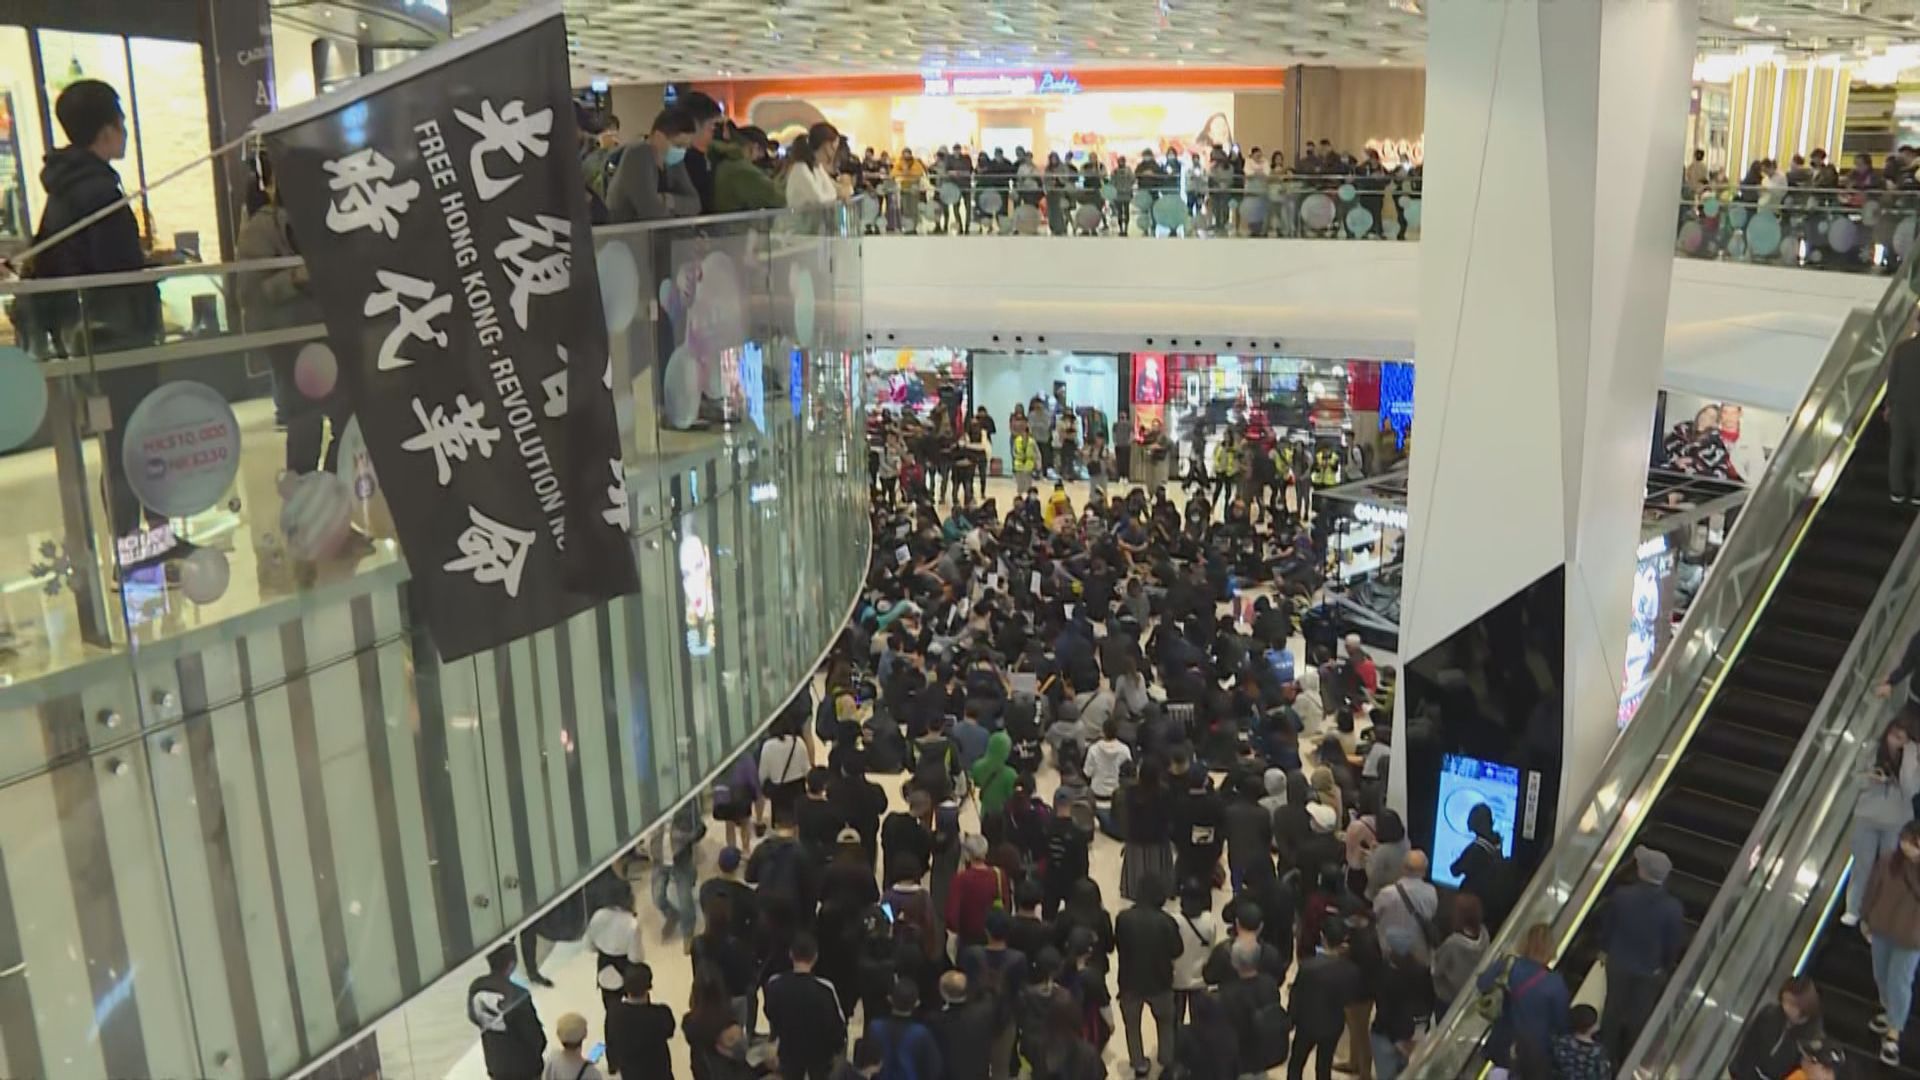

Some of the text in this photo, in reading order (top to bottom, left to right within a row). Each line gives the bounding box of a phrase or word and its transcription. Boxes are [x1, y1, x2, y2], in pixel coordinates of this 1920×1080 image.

[322, 148, 537, 597] 時代革命
[413, 119, 458, 190] FREE
[439, 191, 479, 268] HONG
[461, 271, 504, 347] KONG
[489, 356, 566, 513] REVOLUTION
